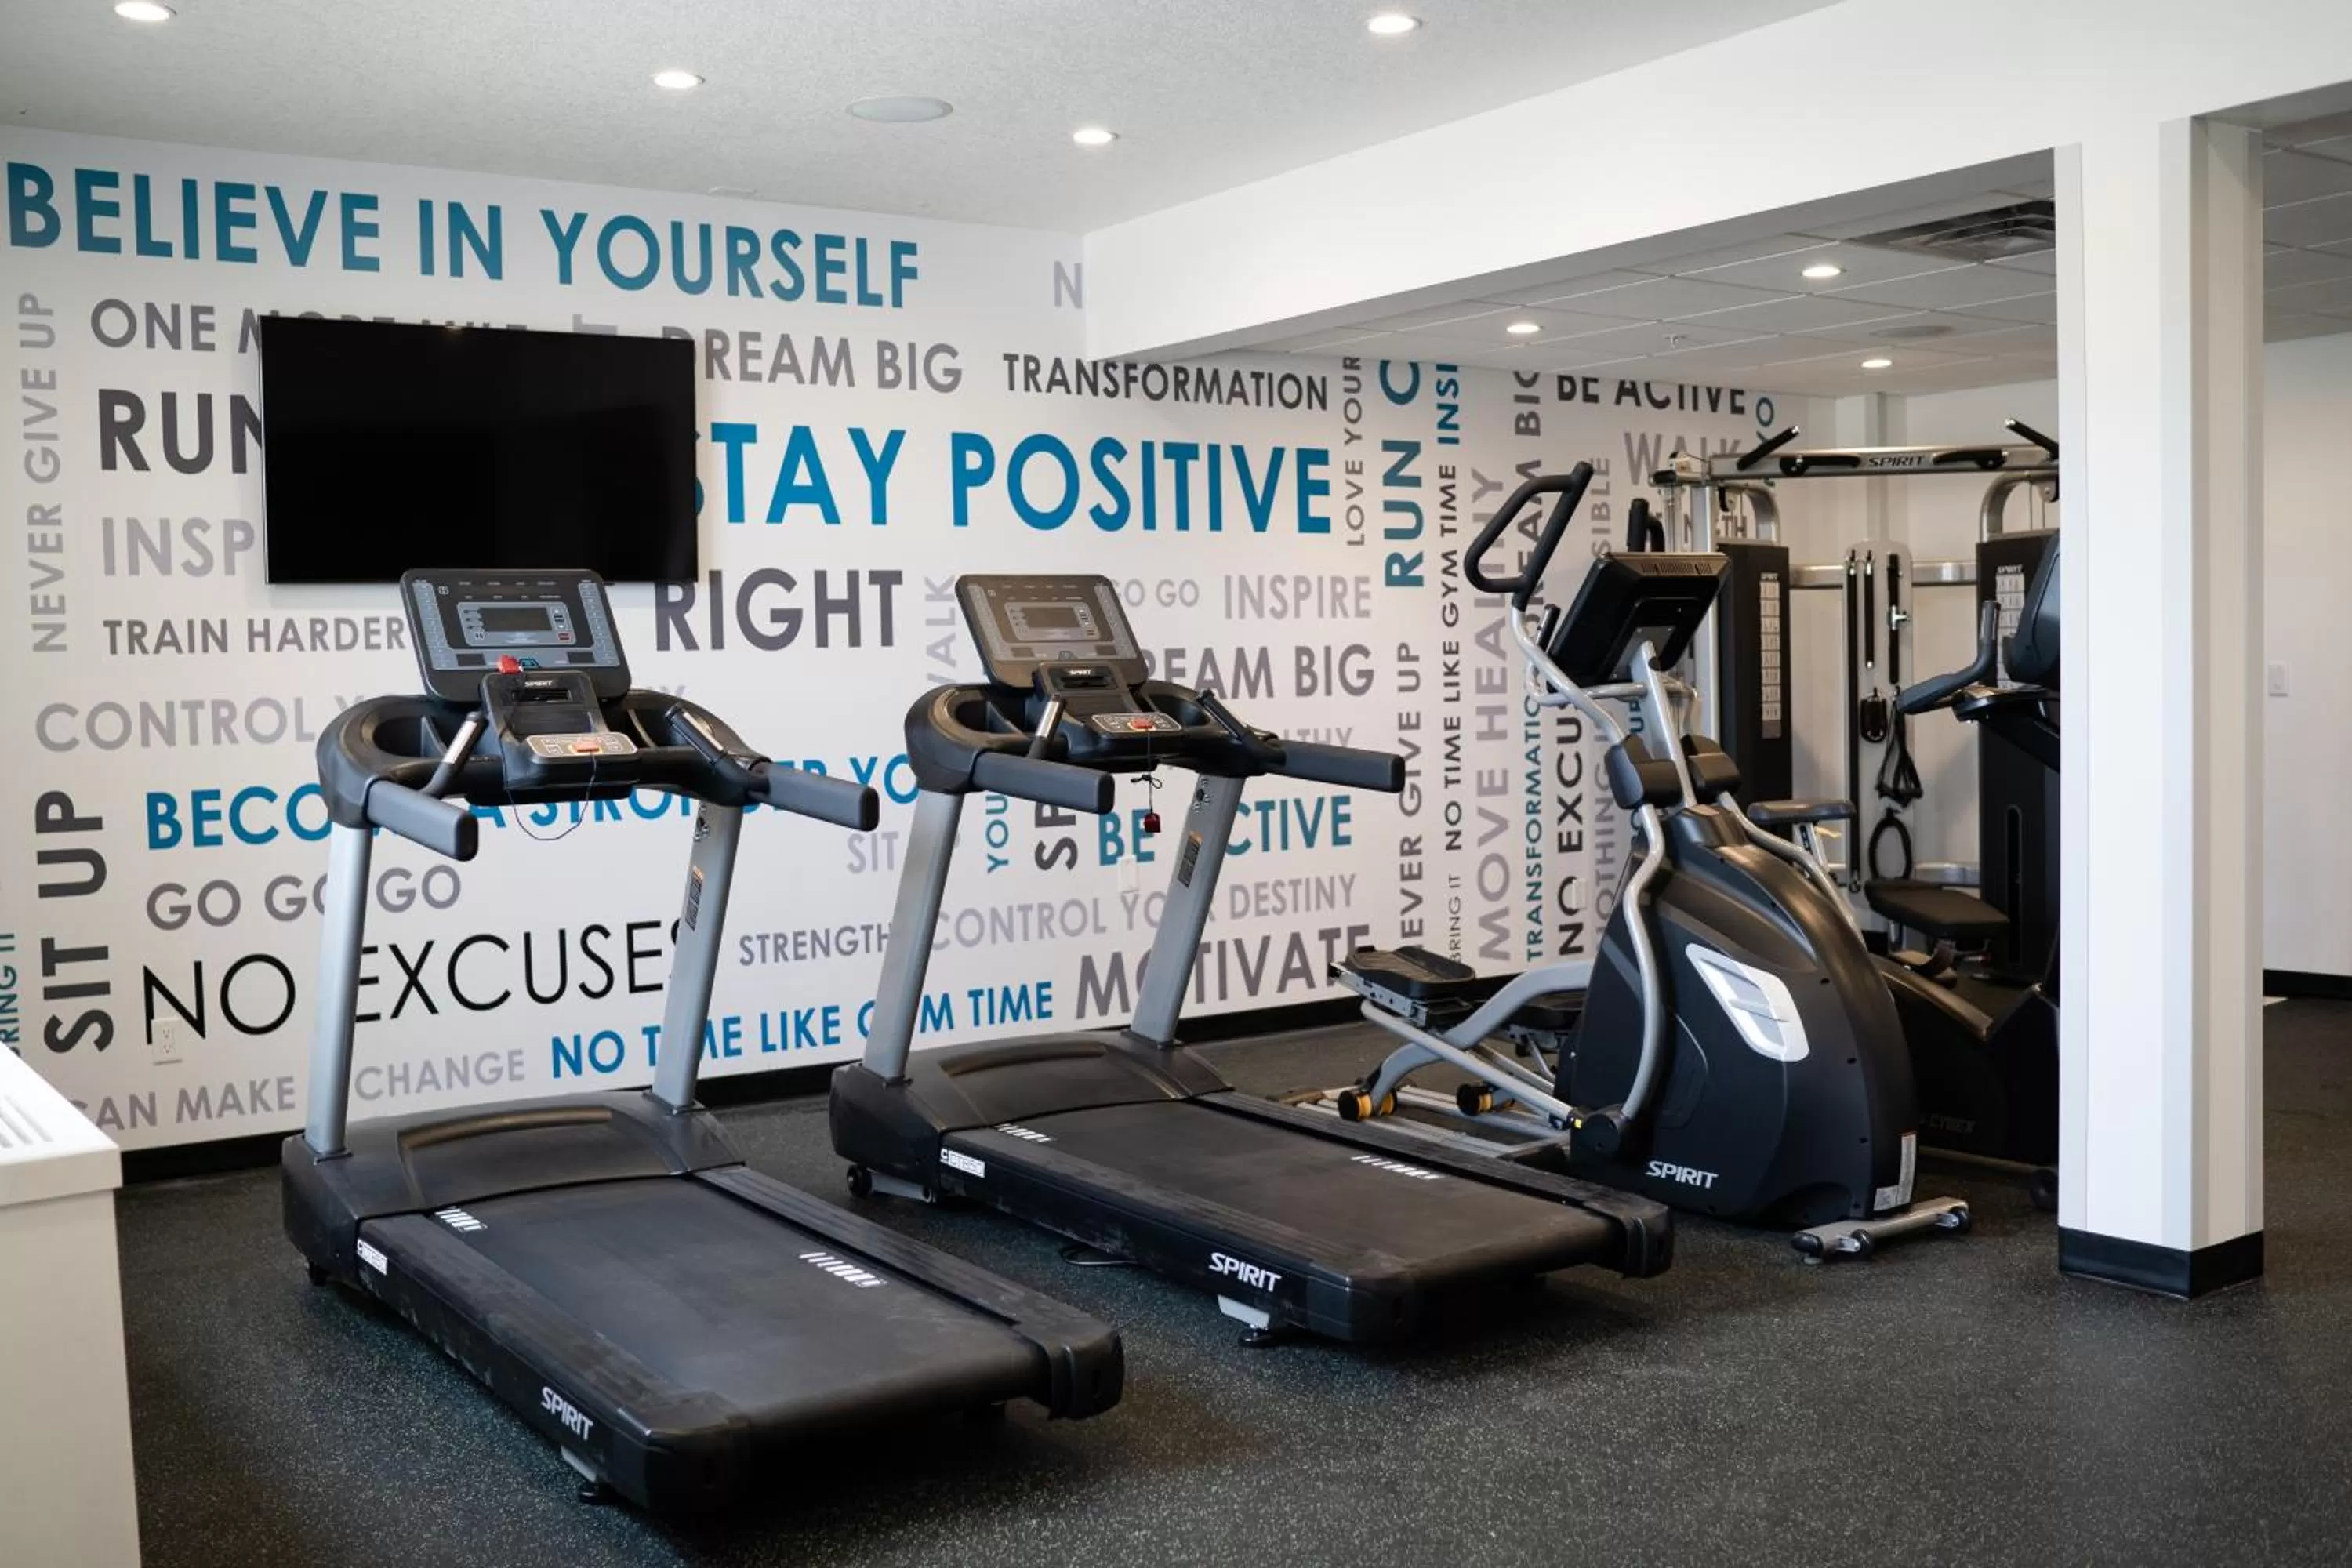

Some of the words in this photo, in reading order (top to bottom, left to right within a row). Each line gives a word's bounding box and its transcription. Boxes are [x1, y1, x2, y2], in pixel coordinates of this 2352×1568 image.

[7, 162, 381, 273] BELIEVE
[418, 198, 503, 281] IN
[539, 205, 919, 308] YOURSELF
[18, 292, 56, 350] UP
[90, 298, 216, 352] ONE
[662, 326, 855, 387] REAM
[877, 339, 962, 394] BIG
[1004, 354, 1328, 411] TRANSFORMATION
[20, 368, 61, 485] GIVE
[1343, 357, 1363, 445] YOUR
[695, 422, 906, 525] TAY
[951, 432, 1330, 534] POSITIVE
[1868, 455, 1926, 468] SPIRIT
[1345, 460, 1365, 546] LOVE
[1381, 439, 1425, 587] RUN
[1439, 465, 1457, 537] TIME
[27, 503, 68, 653] NEVER
[655, 568, 902, 652] RIGHT
[1156, 579, 1200, 607] GO
[1225, 575, 1370, 619] INSPIRE
[1441, 550, 1459, 627] GYM
[103, 619, 228, 655] TRAIN
[247, 617, 407, 653] HARDER
[1397, 642, 1420, 691] UP
[1295, 644, 1375, 697] BIG
[1443, 641, 1461, 702] LIKE
[35, 697, 315, 752] CONTROL
[1444, 716, 1461, 788] TIME
[1556, 705, 1582, 853] EXCU
[35, 790, 107, 898] UP
[147, 782, 332, 851] BECO
[1098, 809, 1156, 866] BE
[1225, 794, 1352, 856] CTIVE
[1445, 801, 1462, 851] NO
[1524, 695, 1544, 962] TRANSFORMATIO
[1595, 763, 1616, 933] OTHING
[847, 831, 899, 873] SIT
[1449, 873, 1460, 888] IT
[1477, 768, 1512, 961] MOVE
[147, 879, 241, 931] GO
[376, 864, 461, 913] GO
[1229, 873, 1356, 920] DESTINY
[1400, 834, 1424, 949] EVER
[739, 923, 891, 966] STRENGTH
[41, 937, 114, 1053] SIT
[143, 953, 296, 1045] NO
[356, 920, 681, 1023] EXCUSE
[968, 982, 1053, 1027] TIME
[355, 1050, 525, 1101] CHANGE
[553, 1030, 625, 1079] NO
[642, 1016, 742, 1066] TME
[760, 1005, 840, 1053] LIKE
[70, 1091, 156, 1131] AN
[176, 1076, 296, 1123] MAKE
[1646, 1160, 1719, 1189] SPIRIT
[1209, 1252, 1282, 1293] SPIRIT
[541, 1386, 593, 1441] SPIRIT
